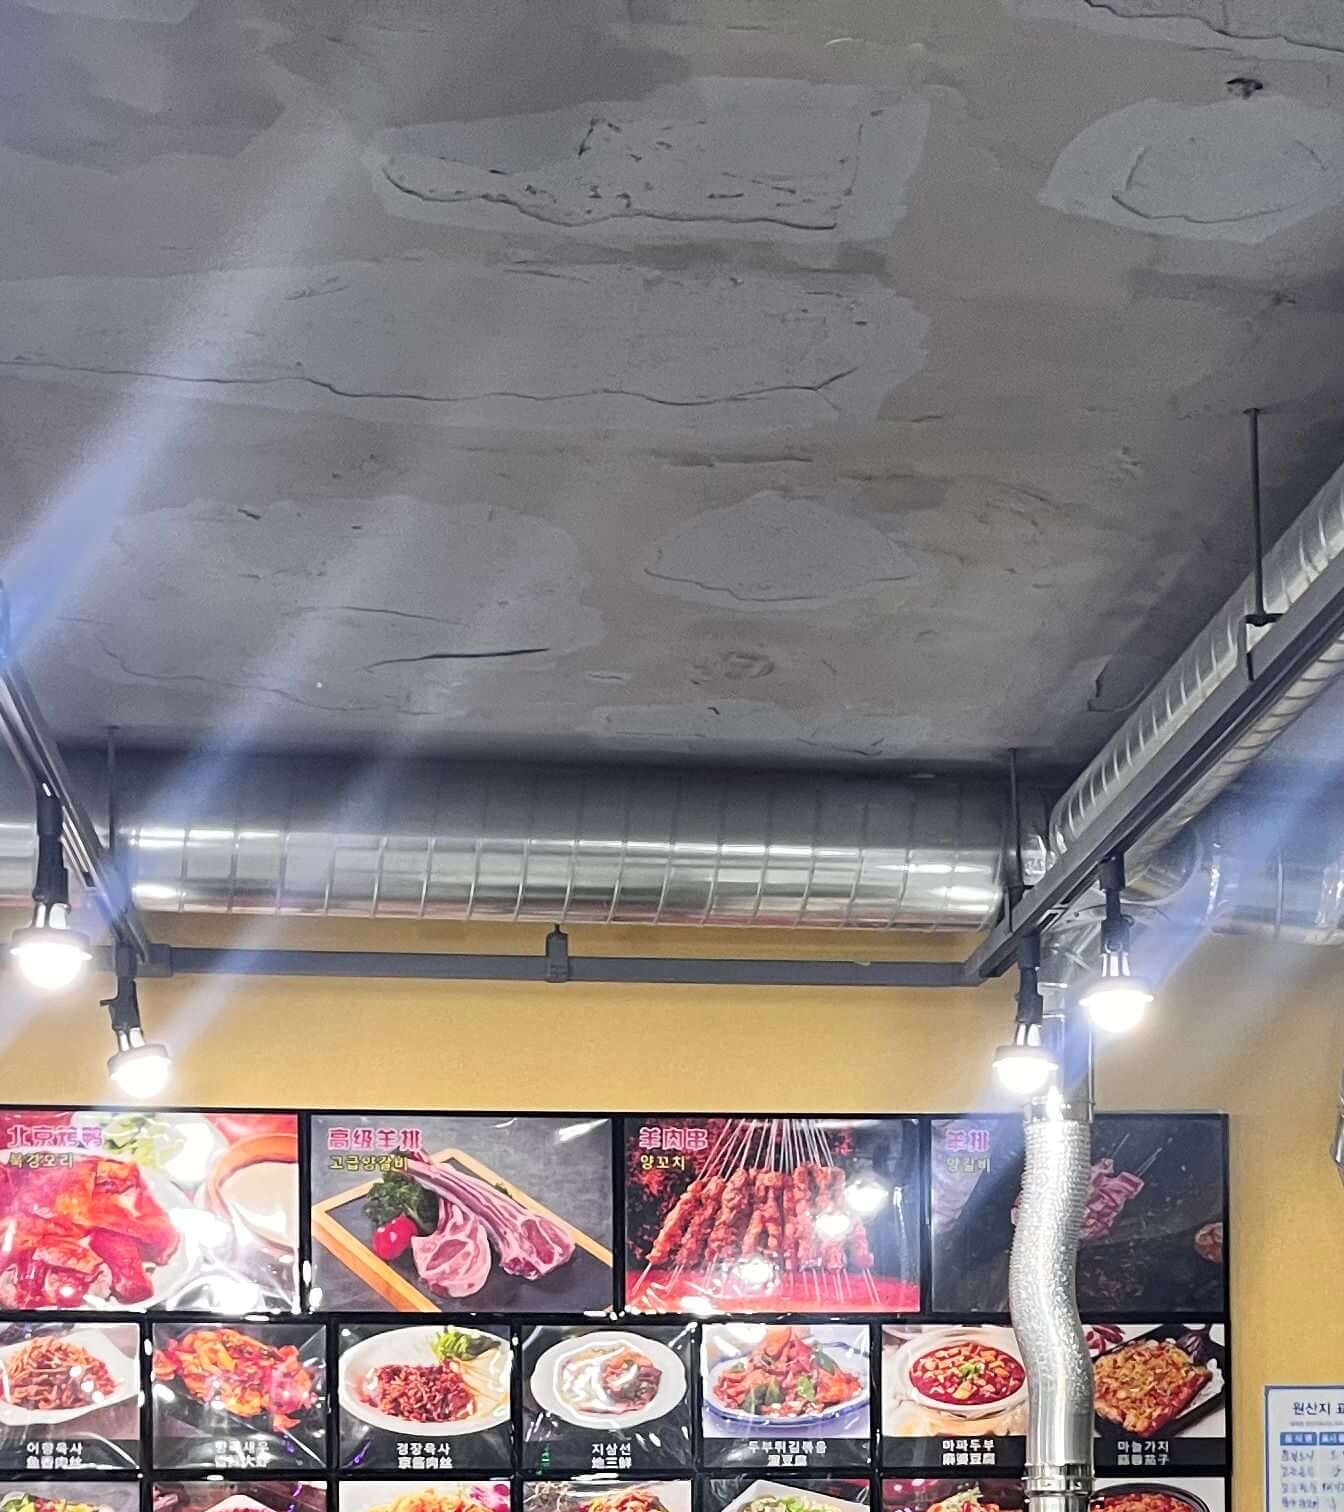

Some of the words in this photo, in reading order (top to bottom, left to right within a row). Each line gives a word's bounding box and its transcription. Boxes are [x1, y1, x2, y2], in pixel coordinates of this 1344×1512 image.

[639, 1126, 708, 1151] 羊肉串
[329, 1153, 409, 1172] 고급양갈비
[640, 1154, 685, 1171] 양꼬치
[946, 1156, 991, 1174] 양갈비
[1293, 1401, 1331, 1416] 원산지
[592, 1442, 632, 1456] 지삼선
[748, 1440, 827, 1454] 두부튀김볶음
[942, 1439, 995, 1452] 마파두부
[1117, 1440, 1169, 1453] 마늘가지
